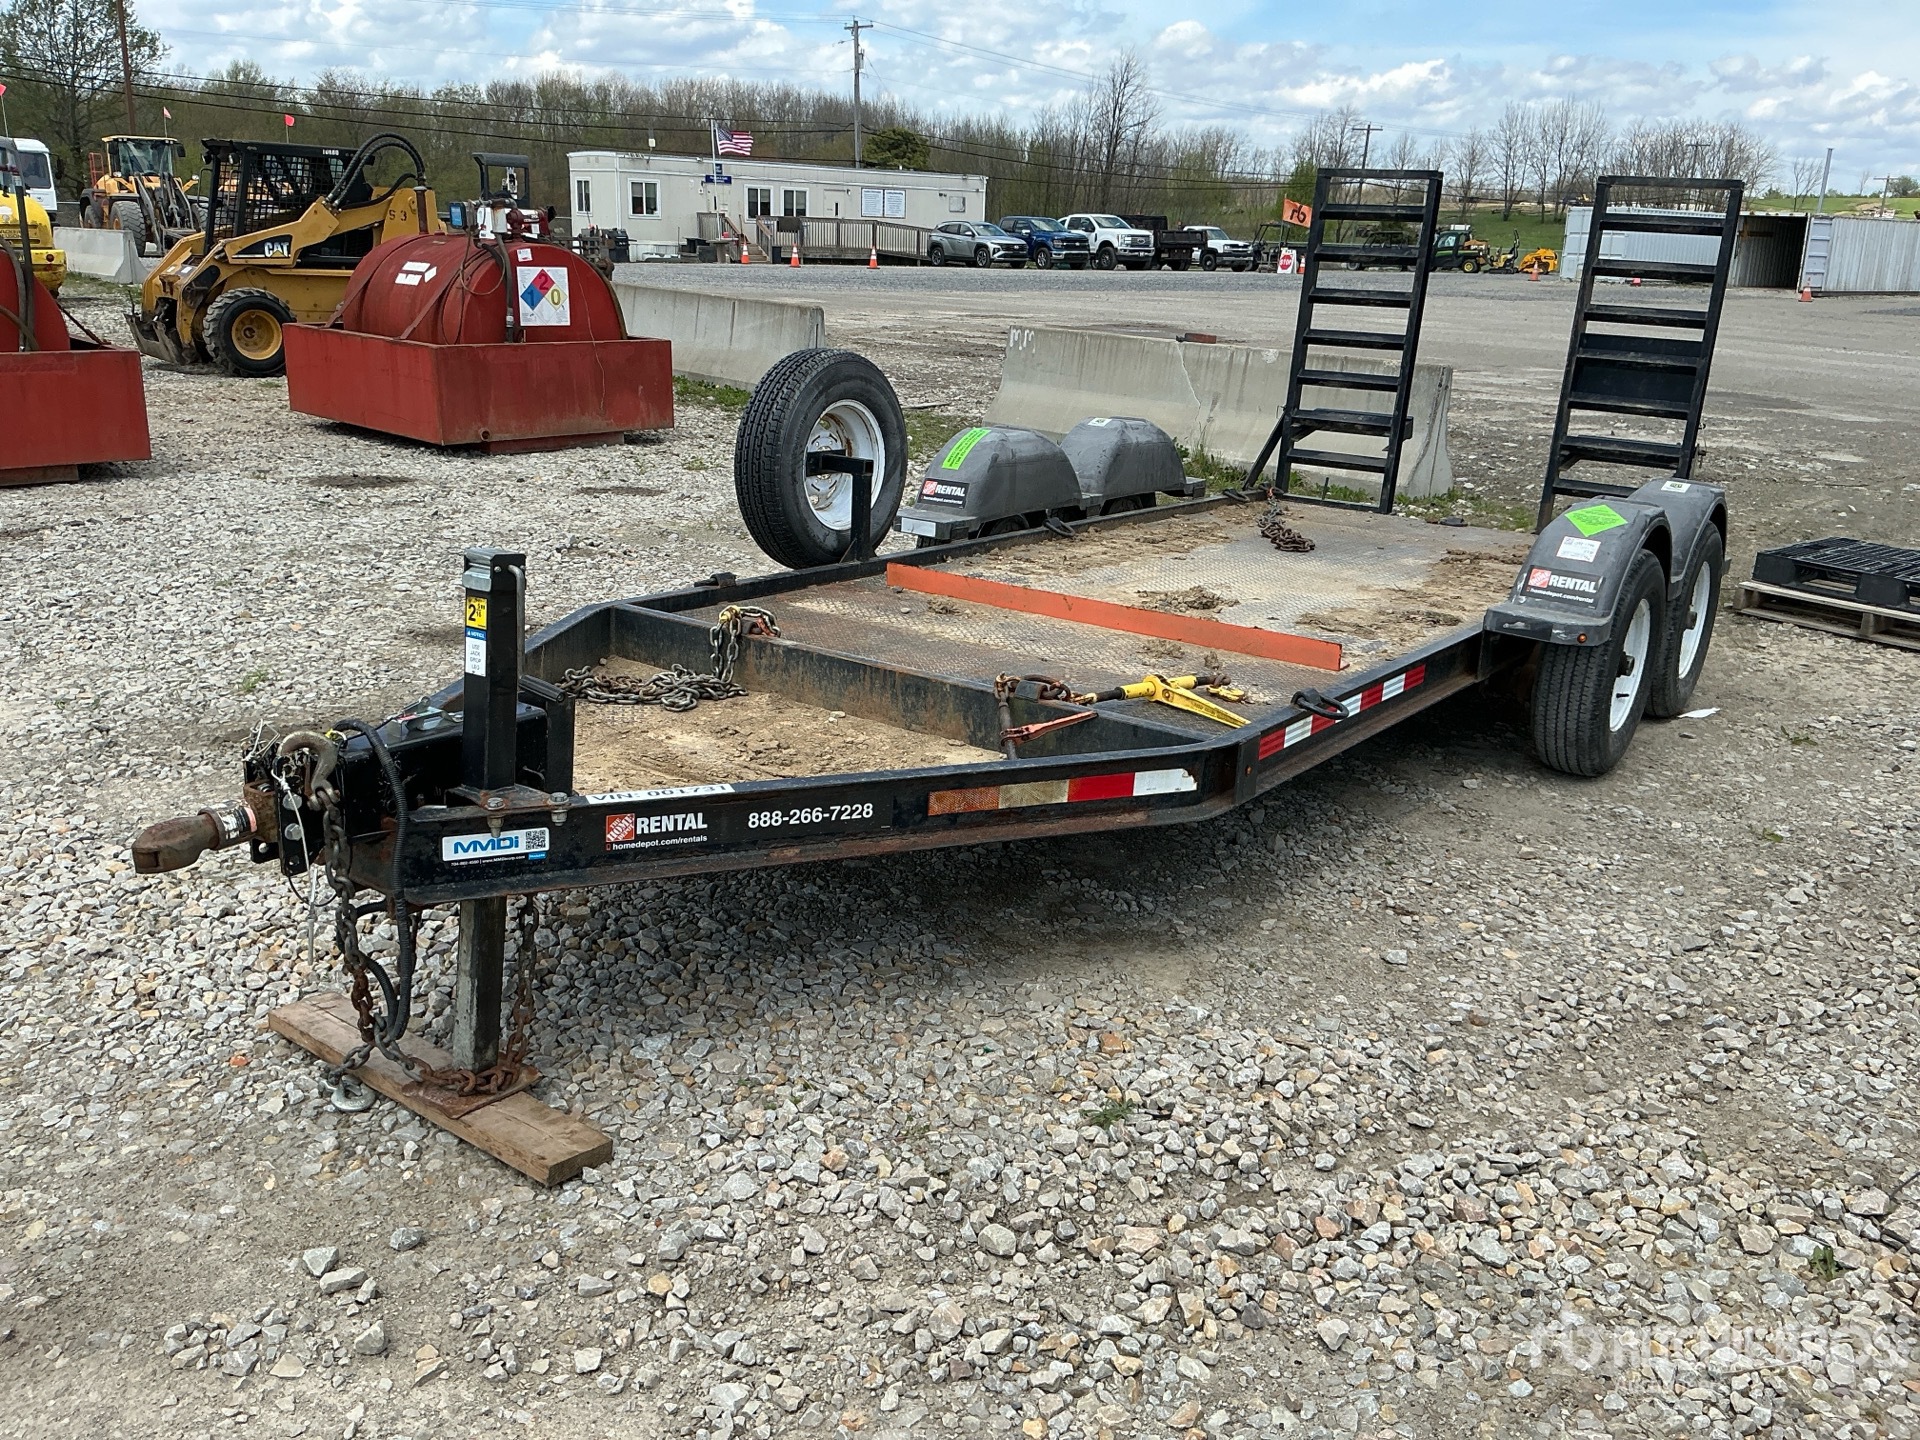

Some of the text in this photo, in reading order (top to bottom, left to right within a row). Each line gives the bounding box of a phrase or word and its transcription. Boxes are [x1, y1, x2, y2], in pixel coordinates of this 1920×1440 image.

[264, 241, 289, 258] CAT
[1279, 258, 1292, 267] STOP
[538, 272, 549, 291] 2
[527, 289, 535, 307] 1
[550, 288, 561, 306] 0
[935, 484, 966, 497] RENTAL
[1549, 574, 1597, 594] RENTAL
[468, 603, 476, 622] 2
[591, 793, 641, 801] VIN:
[636, 812, 708, 835] RENTAL
[748, 803, 873, 829] 888-266-7228
[607, 814, 634, 841] HOME
[453, 836, 519, 854] MMDi
[612, 835, 708, 851] homedepot.com/rentals
